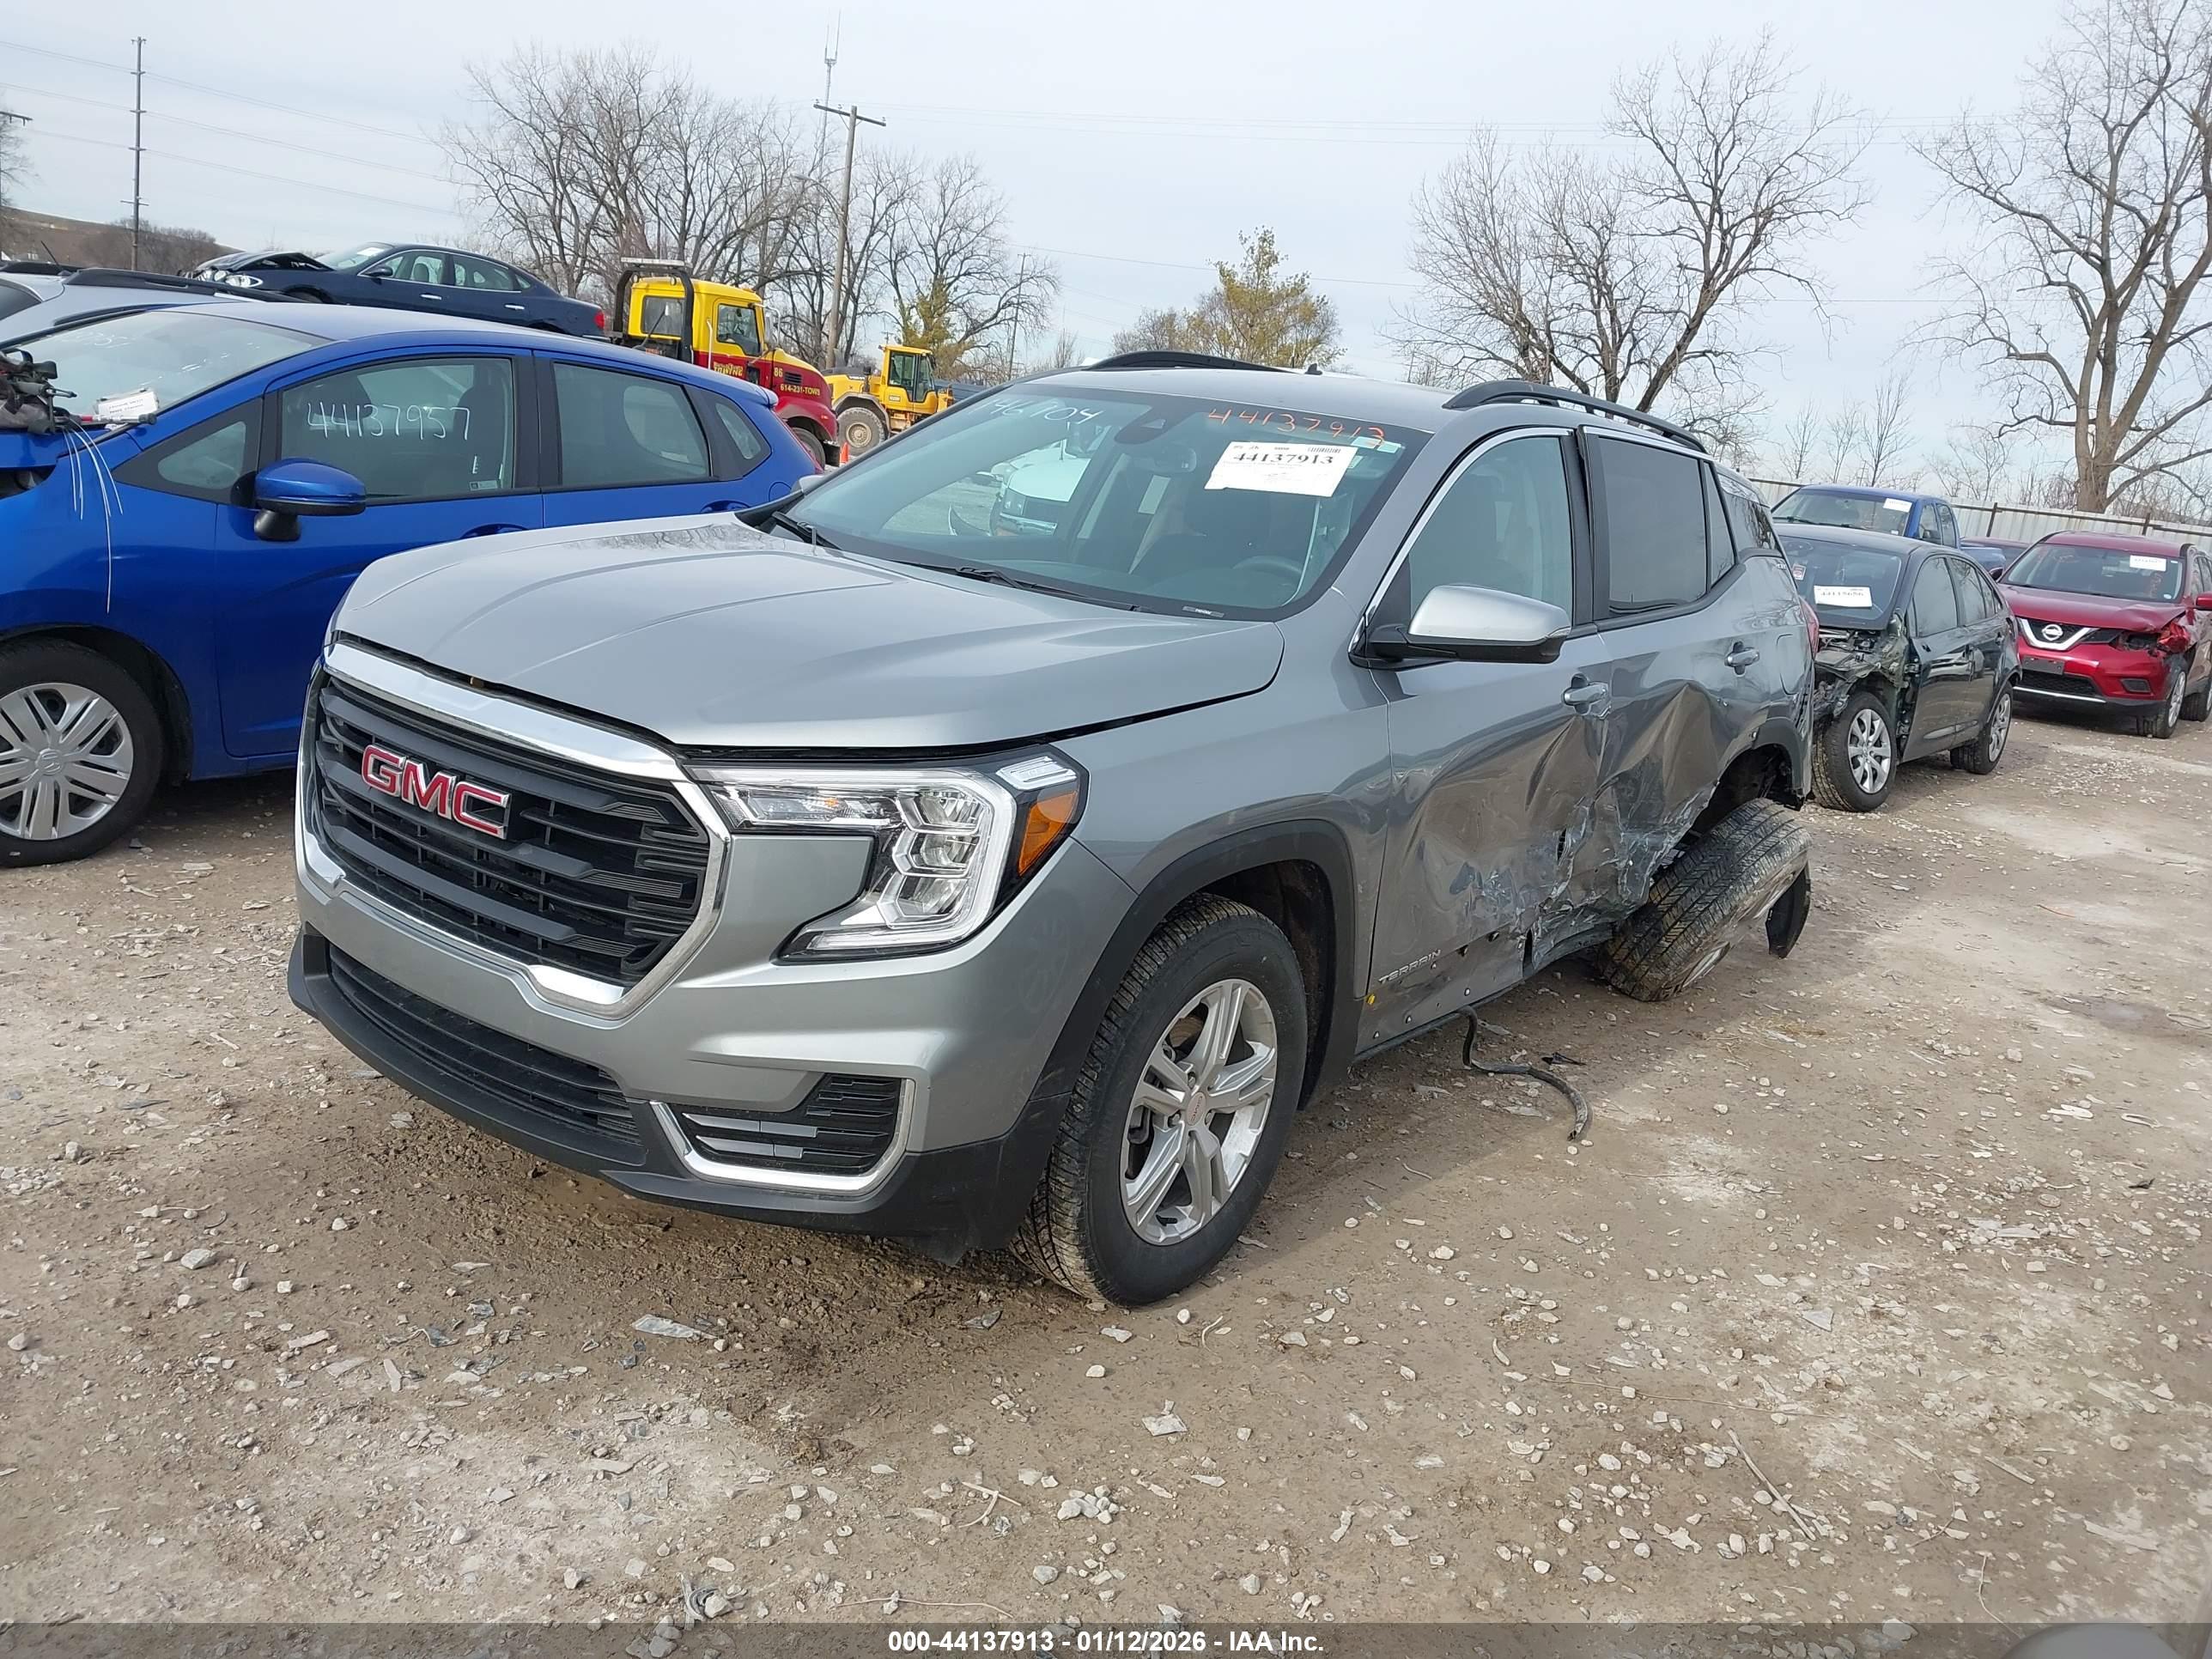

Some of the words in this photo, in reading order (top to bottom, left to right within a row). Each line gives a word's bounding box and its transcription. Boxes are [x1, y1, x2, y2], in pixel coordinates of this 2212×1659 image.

[774, 367, 783, 378] 86
[307, 401, 471, 441] 44137957
[1208, 408, 1385, 446] 44137913
[1233, 453, 1334, 465] 44137913
[362, 744, 511, 840] GMC
[1378, 949, 1442, 984] TERRAIN
